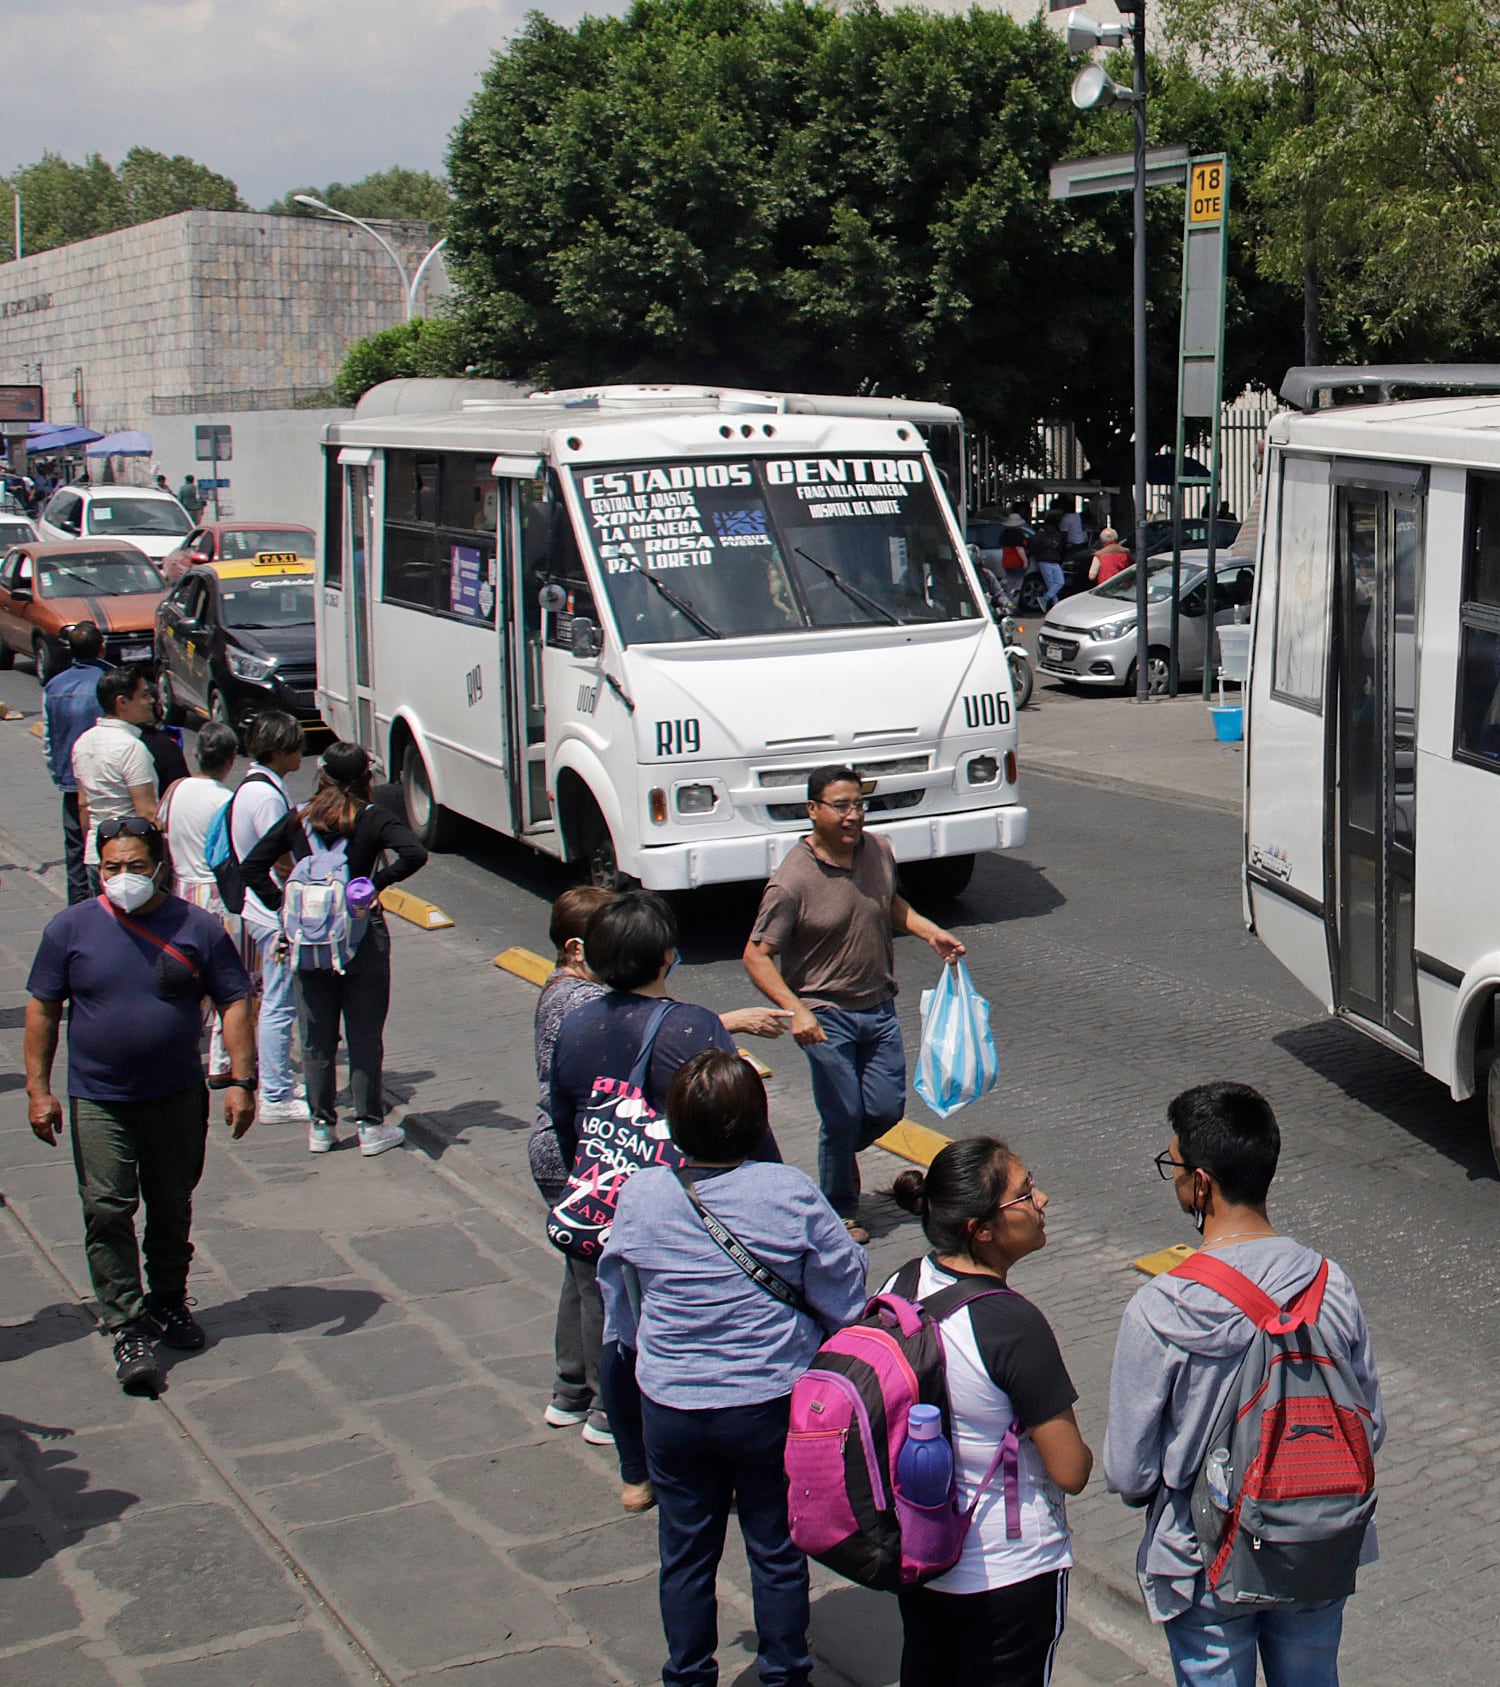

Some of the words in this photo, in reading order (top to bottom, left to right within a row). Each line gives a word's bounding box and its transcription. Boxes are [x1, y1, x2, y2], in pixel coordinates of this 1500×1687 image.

[1196, 168, 1220, 191] 18
[1194, 196, 1220, 214] OTE
[583, 464, 752, 499] ESTADIOS
[766, 459, 925, 485] CENTRO
[590, 496, 635, 514] CENTRAL
[634, 494, 649, 510] DE
[650, 491, 695, 508] ABASTOS
[796, 485, 826, 500] FRAC
[825, 484, 856, 498] VILLA
[856, 483, 909, 497] FRONTERA
[593, 506, 701, 528] XONACA
[808, 503, 852, 519] HOSPITAL
[852, 502, 872, 516] DEL
[871, 500, 901, 514] NORTE
[601, 527, 625, 542] LA
[629, 520, 703, 540] CIENEGA
[719, 534, 768, 542] PARQUE
[600, 542, 636, 558] LA
[645, 535, 715, 553] ROSA
[721, 539, 773, 547] PUEBLA
[262, 554, 295, 565] TAXI
[647, 550, 712, 570] LORETO
[466, 664, 483, 708] R19
[577, 684, 597, 713] U06
[963, 692, 1011, 728] U06
[655, 718, 700, 756] R19
[614, 1127, 653, 1162] SAN
